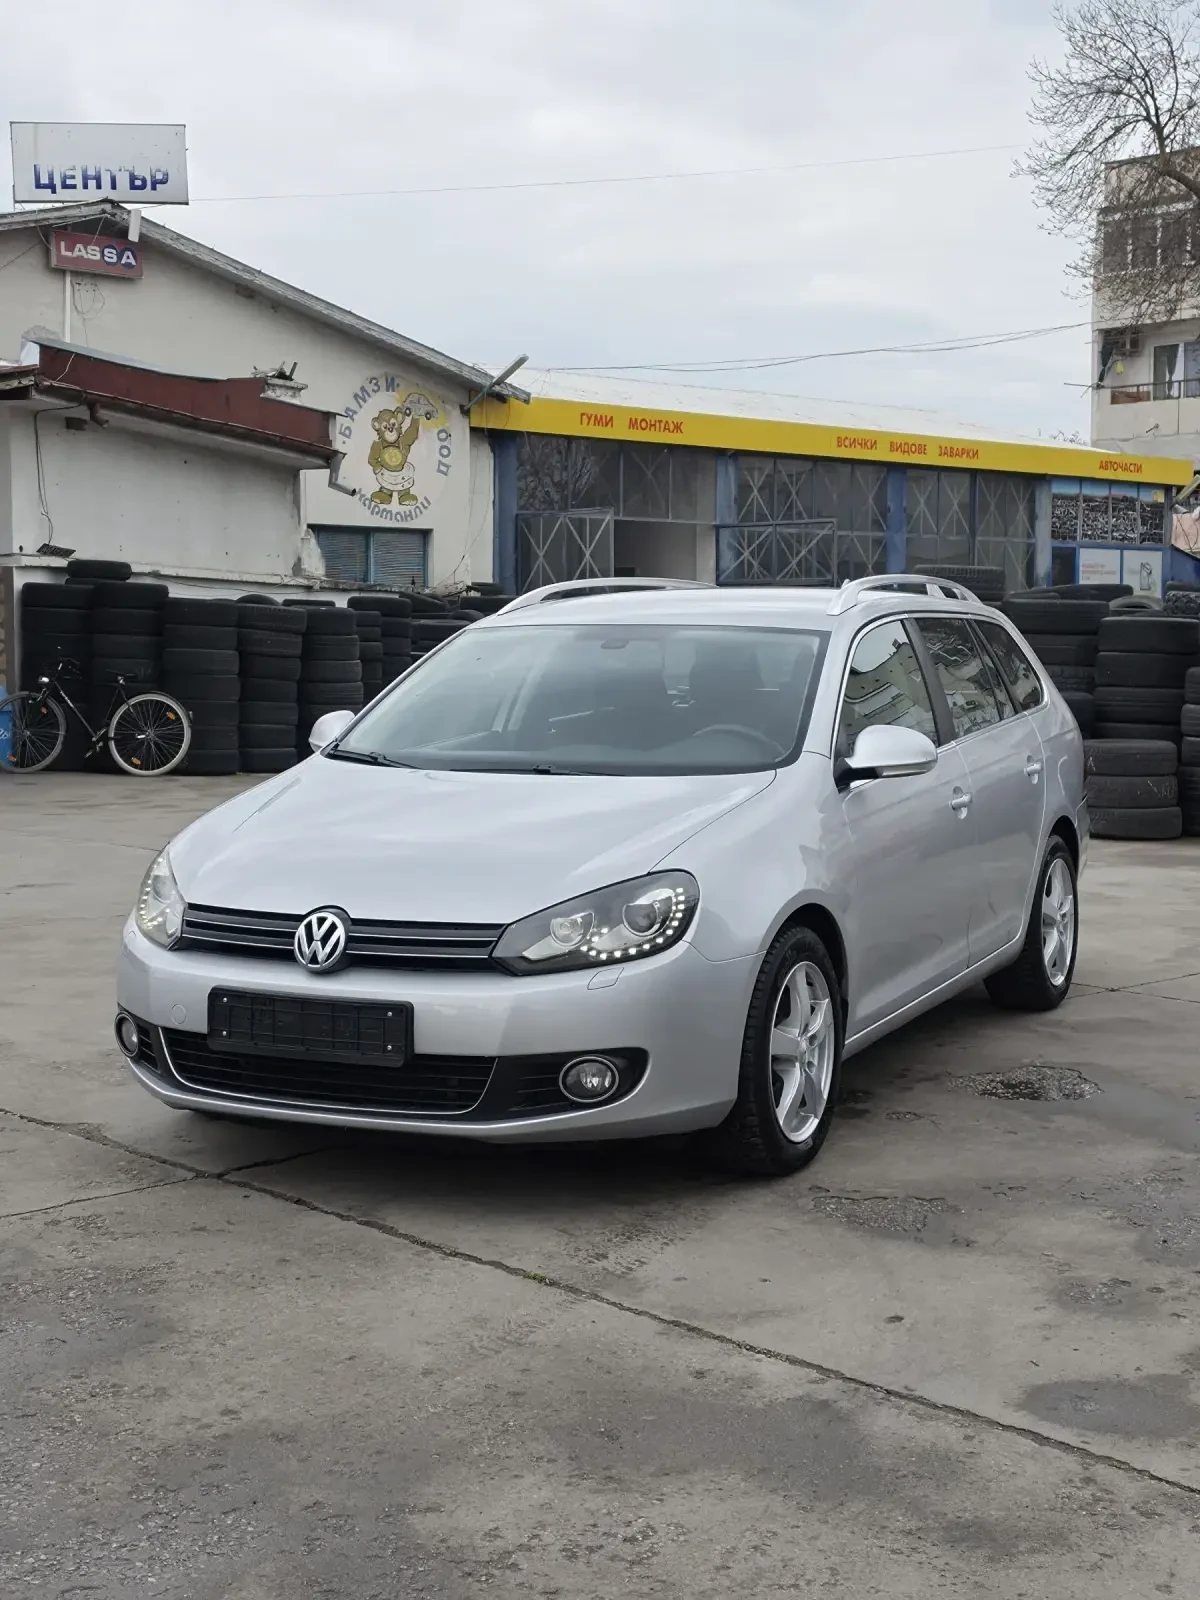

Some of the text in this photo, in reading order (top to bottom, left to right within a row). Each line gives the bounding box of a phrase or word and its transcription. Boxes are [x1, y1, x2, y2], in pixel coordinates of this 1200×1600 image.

[33, 164, 169, 194] ЦЕНТЪР
[60, 241, 137, 267] LASSA
[580, 412, 684, 433] ГУМИ МОНТАЖ
[437, 429, 451, 476] ООД
[836, 436, 979, 460] ВСИЧКИ ВИДОВЕ ЗАВАРКИ
[1099, 460, 1143, 473] АВТОЧАСТИ
[296, 912, 344, 968] VW
